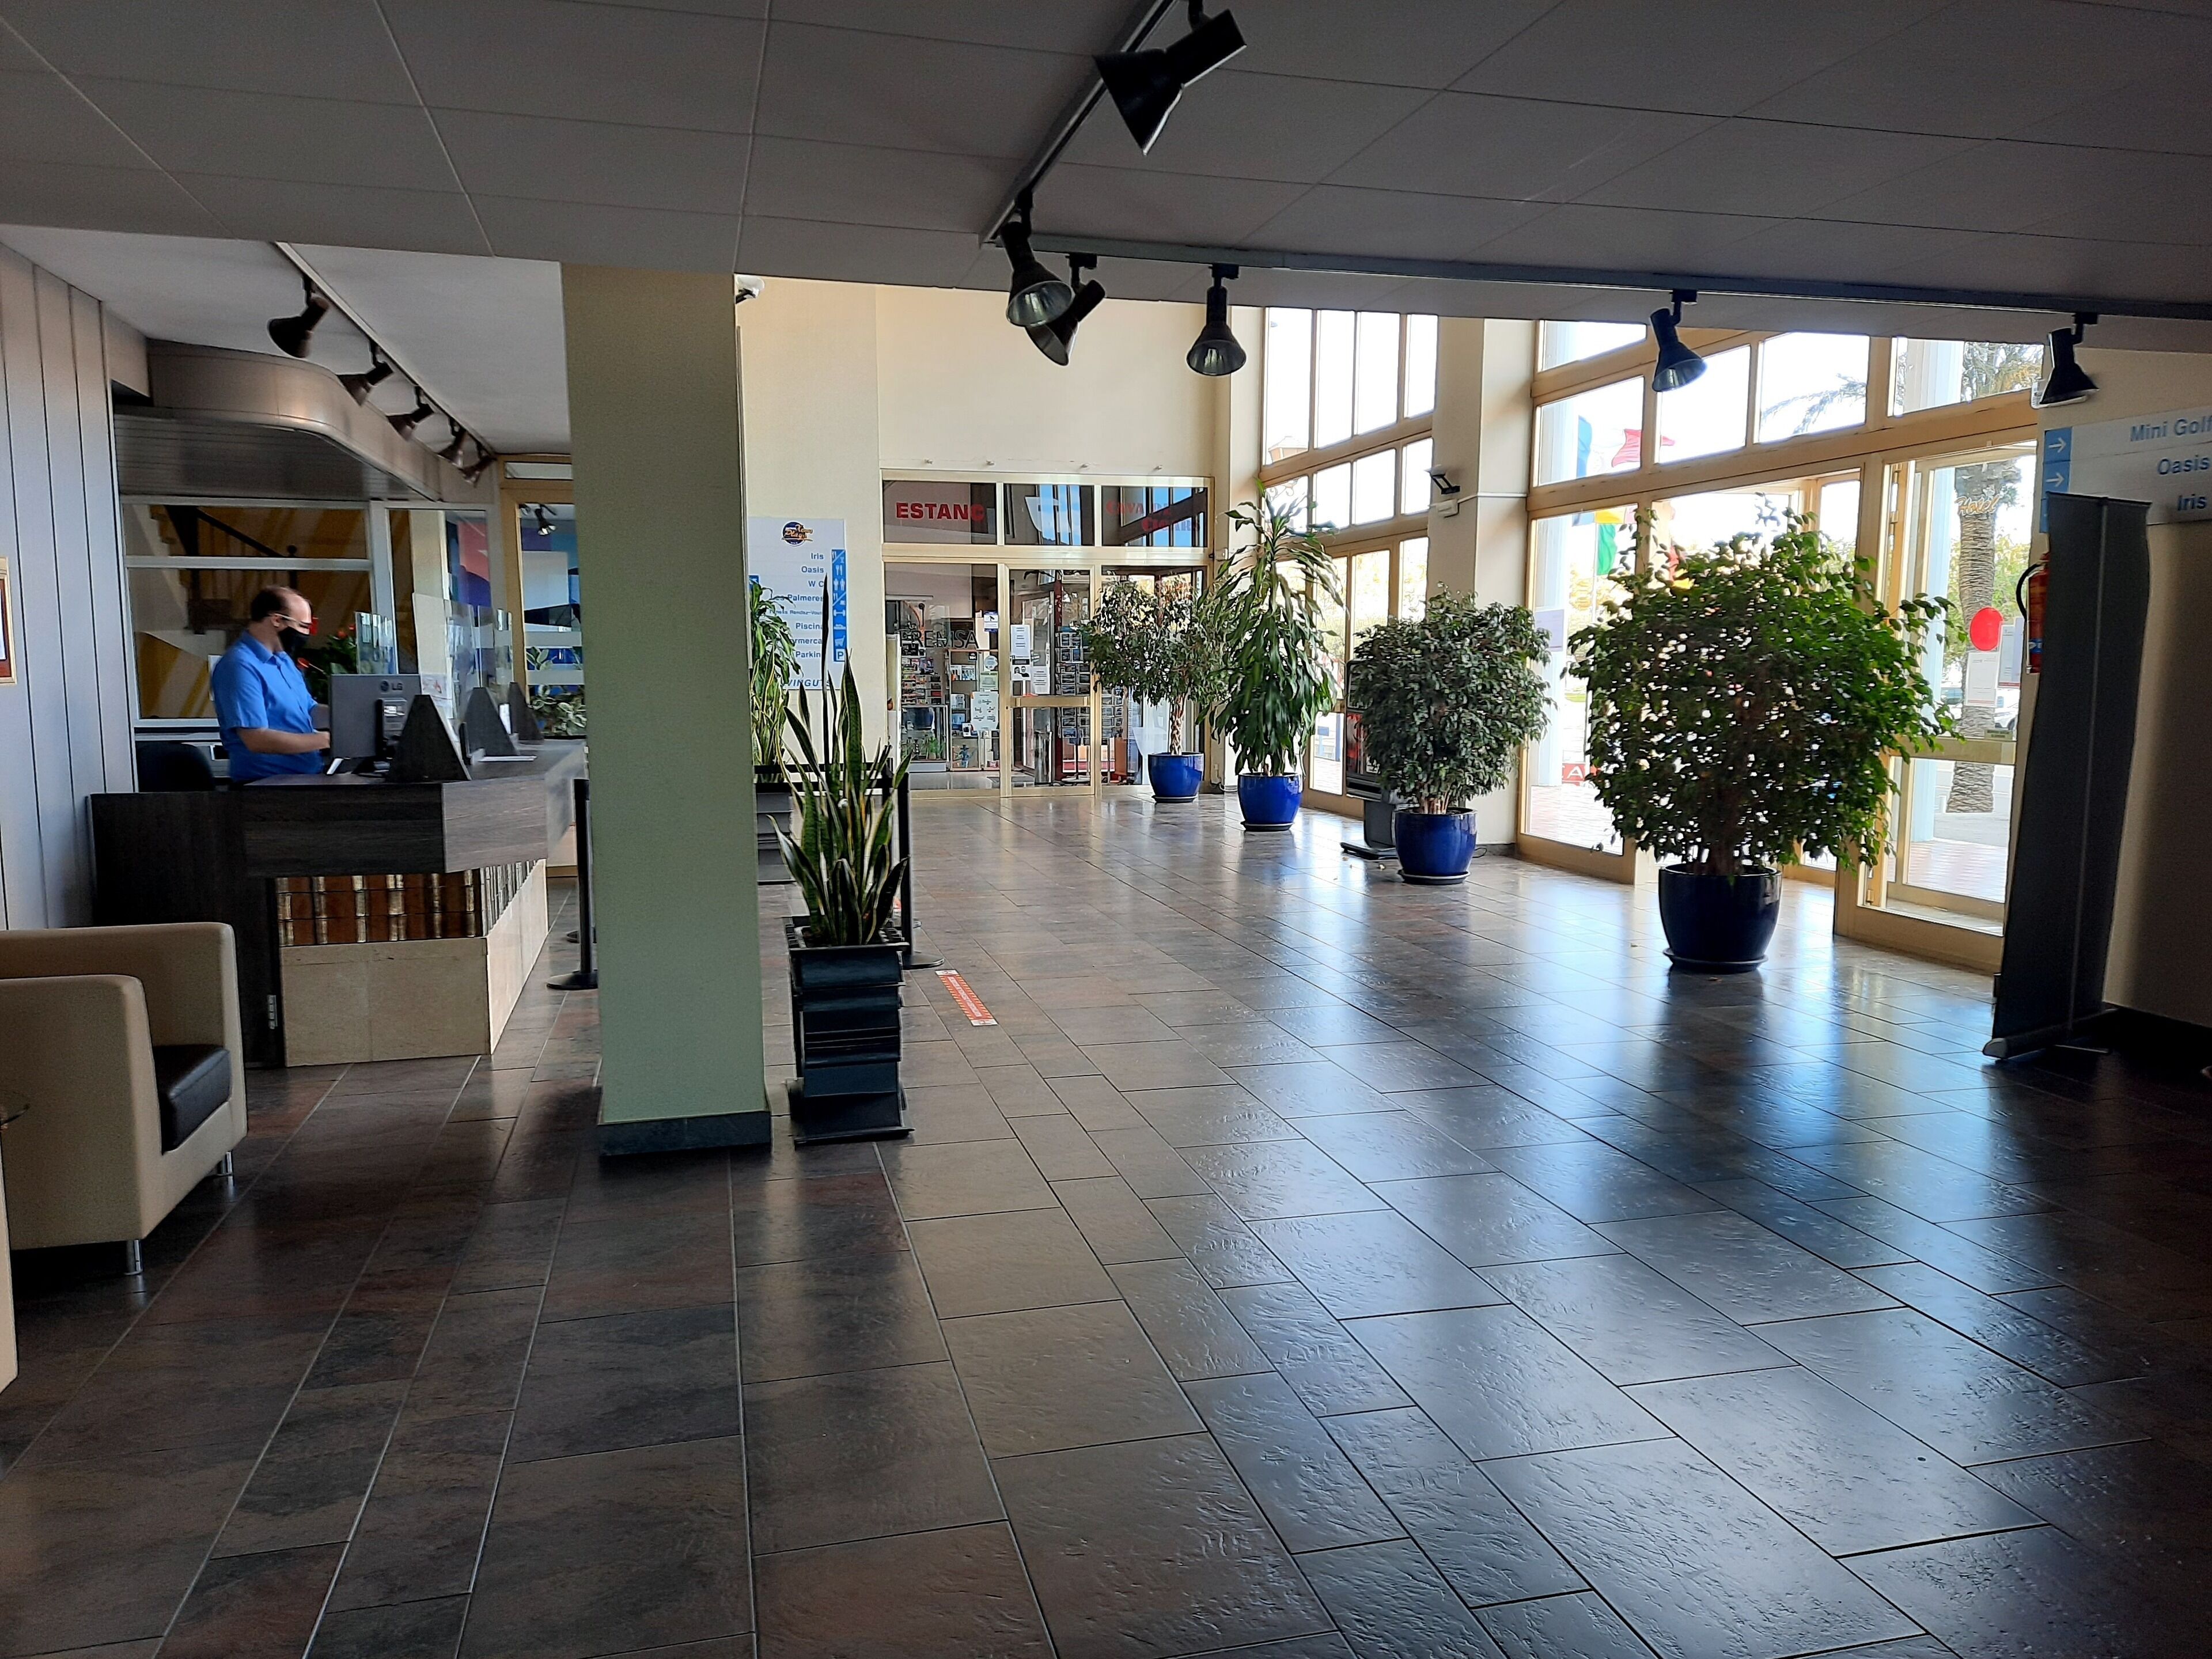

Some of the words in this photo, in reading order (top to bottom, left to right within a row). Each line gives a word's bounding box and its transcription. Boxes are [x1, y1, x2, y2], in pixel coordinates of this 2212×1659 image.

[2131, 421, 2168, 442] Mini
[2175, 415, 2212, 436] Golf
[2158, 454, 2210, 475] Oasis
[1955, 494, 2000, 516] Hotel
[2177, 494, 2207, 512] Iris
[900, 630, 979, 649] PREMSA
[392, 683, 403, 691] LG
